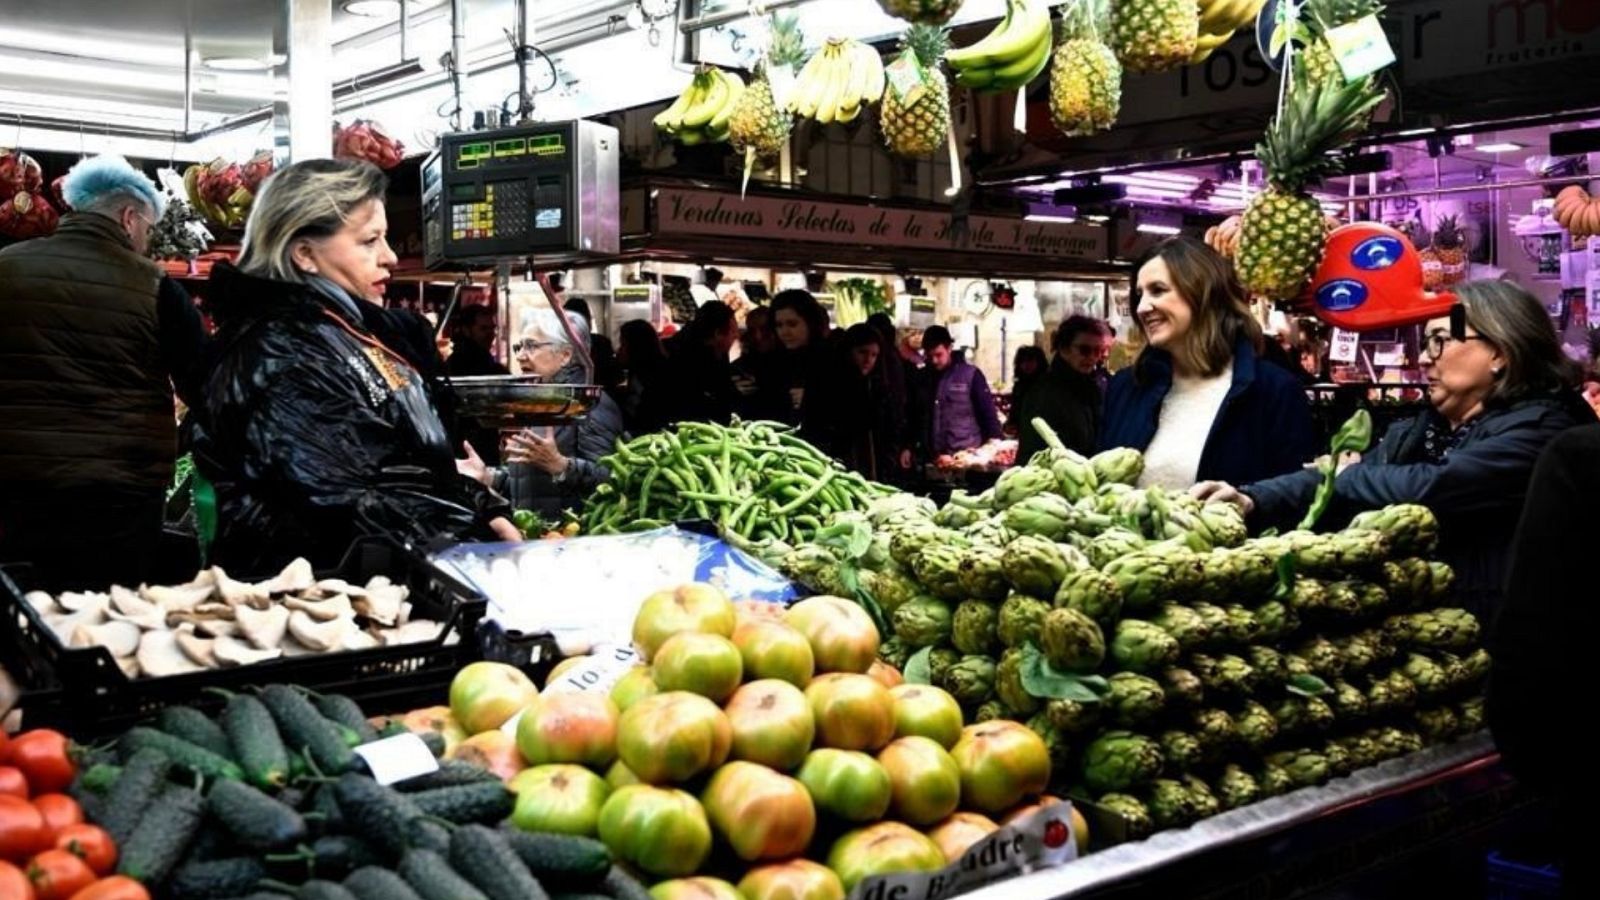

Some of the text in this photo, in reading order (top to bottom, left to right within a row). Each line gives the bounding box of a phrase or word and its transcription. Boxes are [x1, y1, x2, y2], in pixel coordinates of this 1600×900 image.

[670, 195, 763, 227] Verduras
[777, 199, 856, 235] Selectas
[868, 211, 888, 236] de
[903, 214, 922, 239] la
